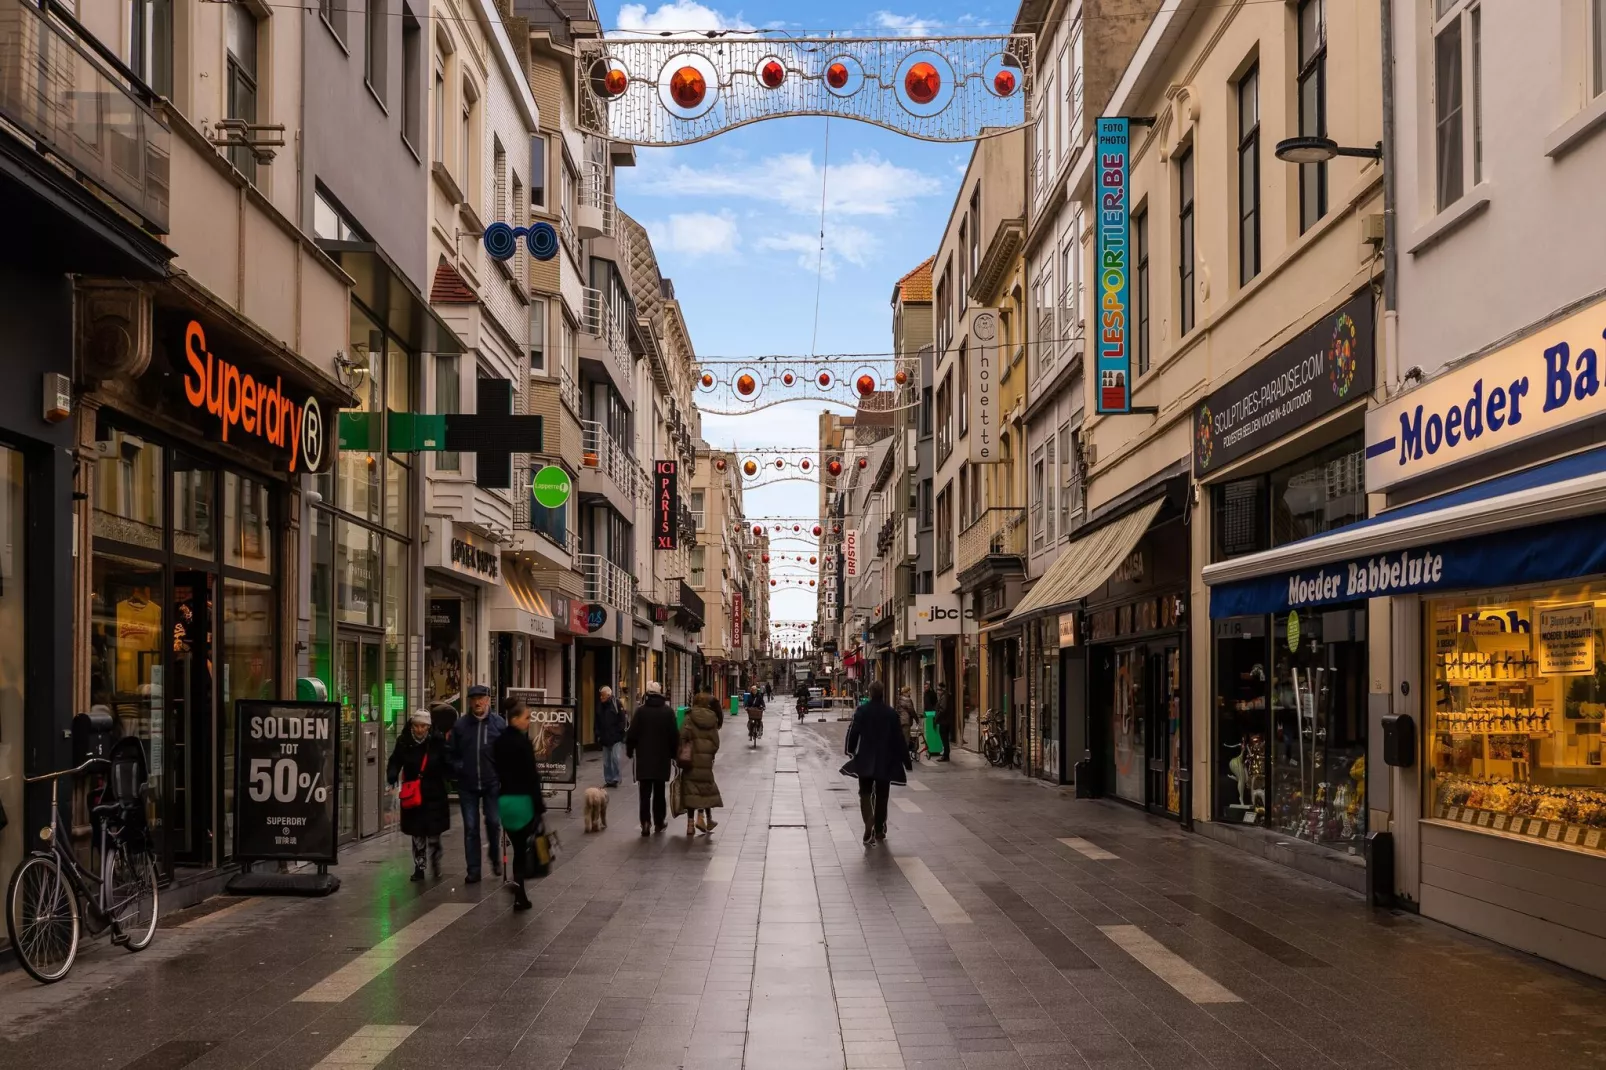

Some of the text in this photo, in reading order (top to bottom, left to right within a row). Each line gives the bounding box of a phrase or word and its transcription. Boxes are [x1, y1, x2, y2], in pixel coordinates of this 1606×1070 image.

[1103, 123, 1123, 132] FOTO
[1100, 136, 1126, 144] PHOTO
[1102, 153, 1125, 358] LESPORTIER.BE
[1286, 389, 1312, 413] OUTDOOR
[1399, 377, 1529, 466] Moeder
[658, 463, 674, 474] ICI
[661, 478, 670, 533] PARIS
[658, 537, 673, 548] XL
[847, 531, 856, 575] BRISTOL
[1288, 551, 1442, 606] Moeder Babbelute
[928, 606, 959, 622] jbc
[530, 711, 573, 723] SOLDEN
[251, 717, 328, 739] SOLDEN
[280, 743, 298, 755] TOT
[249, 758, 327, 803] 50%
[266, 816, 307, 825] SUPERDRY
